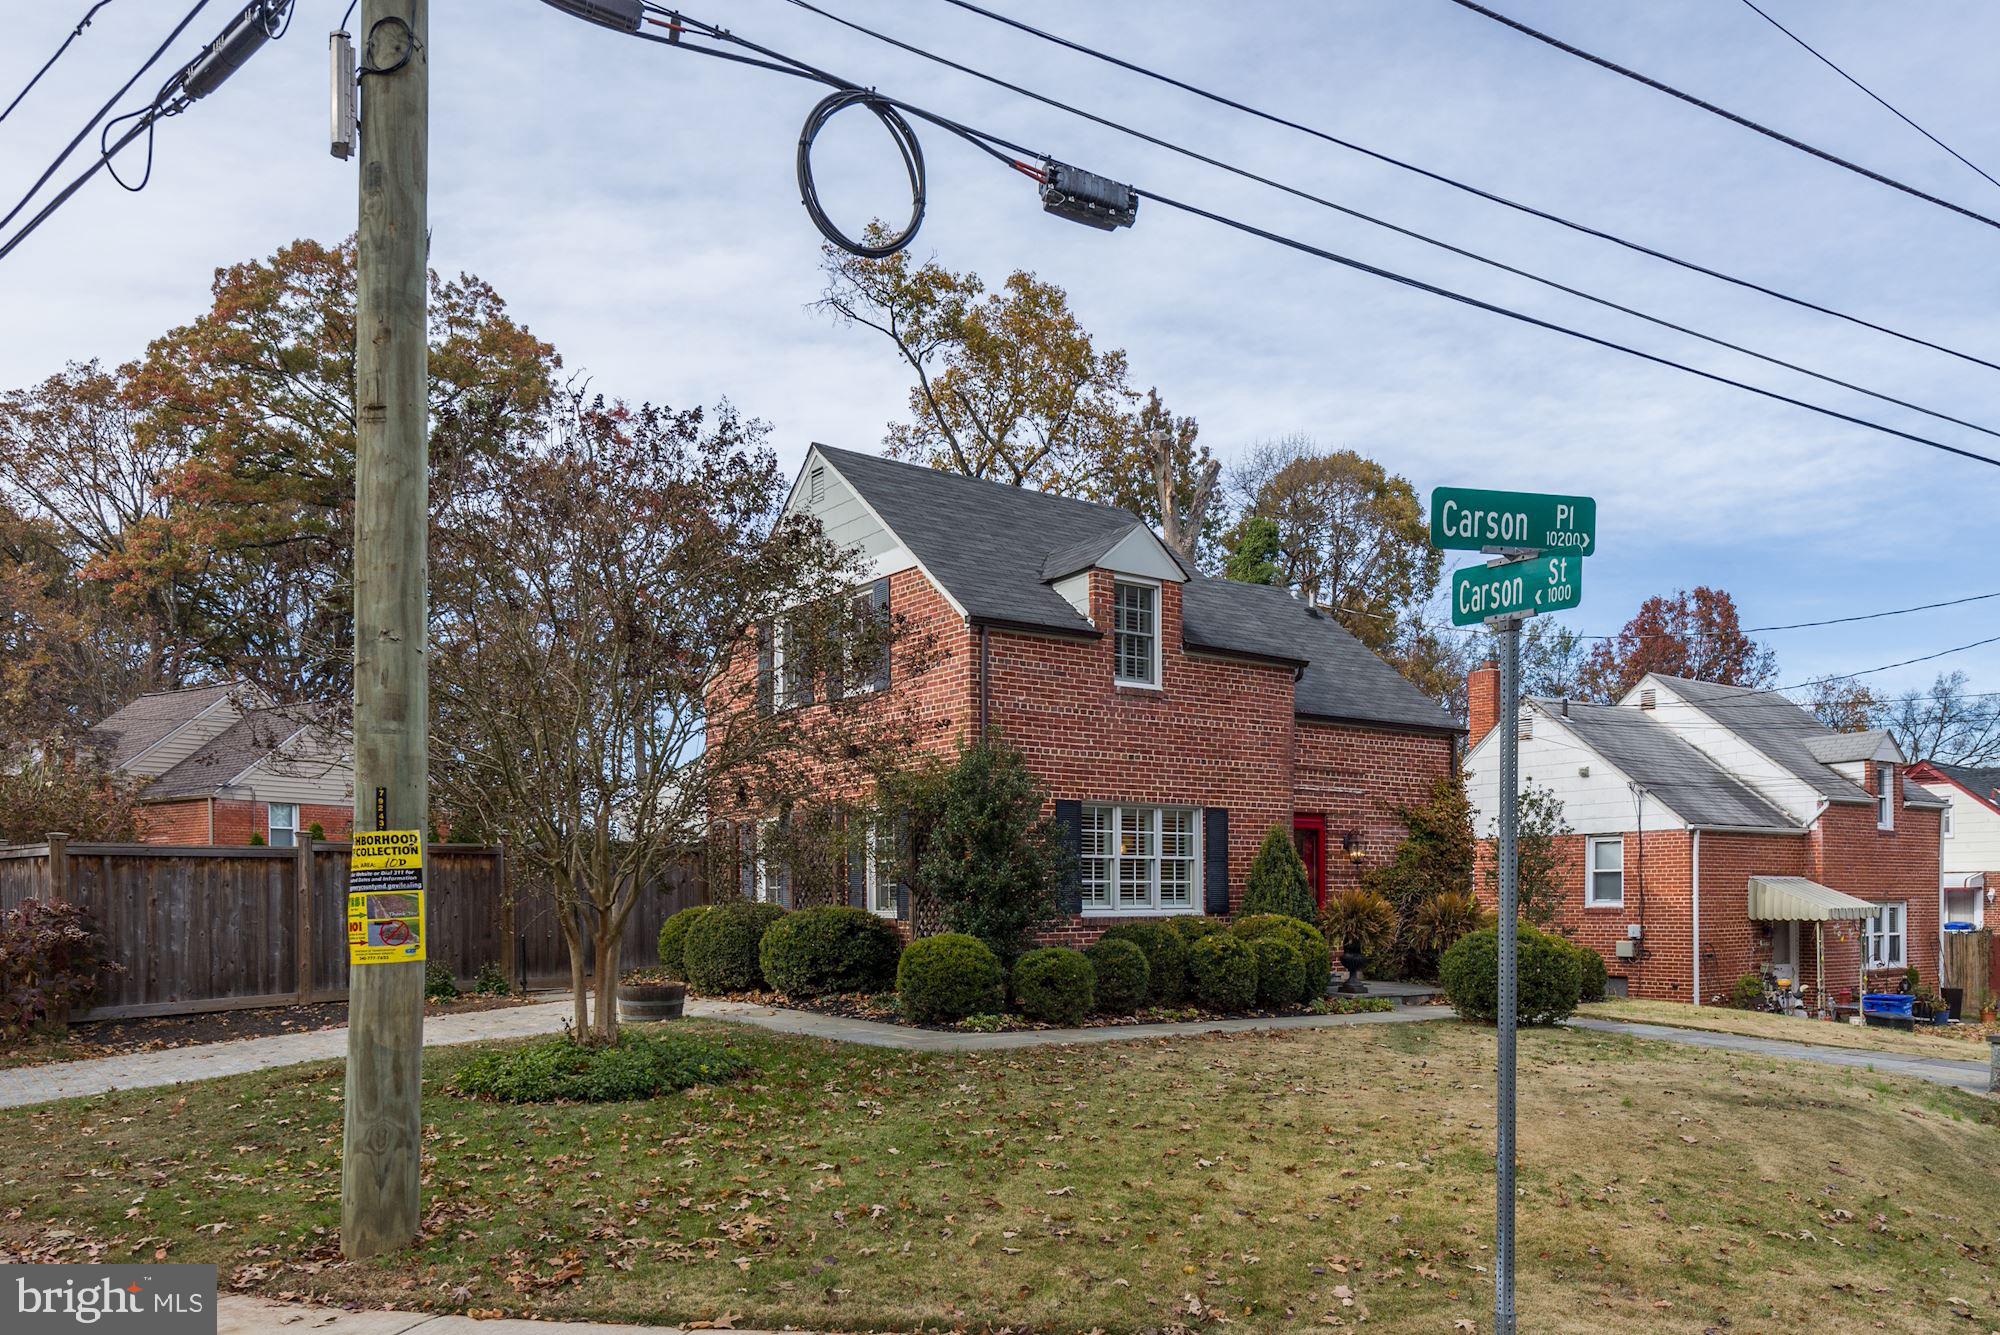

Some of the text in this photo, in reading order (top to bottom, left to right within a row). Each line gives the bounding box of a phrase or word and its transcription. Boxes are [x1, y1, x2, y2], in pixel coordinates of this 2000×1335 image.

[1442, 500, 1574, 541] Carson Pl
[1546, 531, 1581, 546] 10200
[1459, 557, 1567, 615] Carson St
[1547, 584, 1572, 603] 1000
